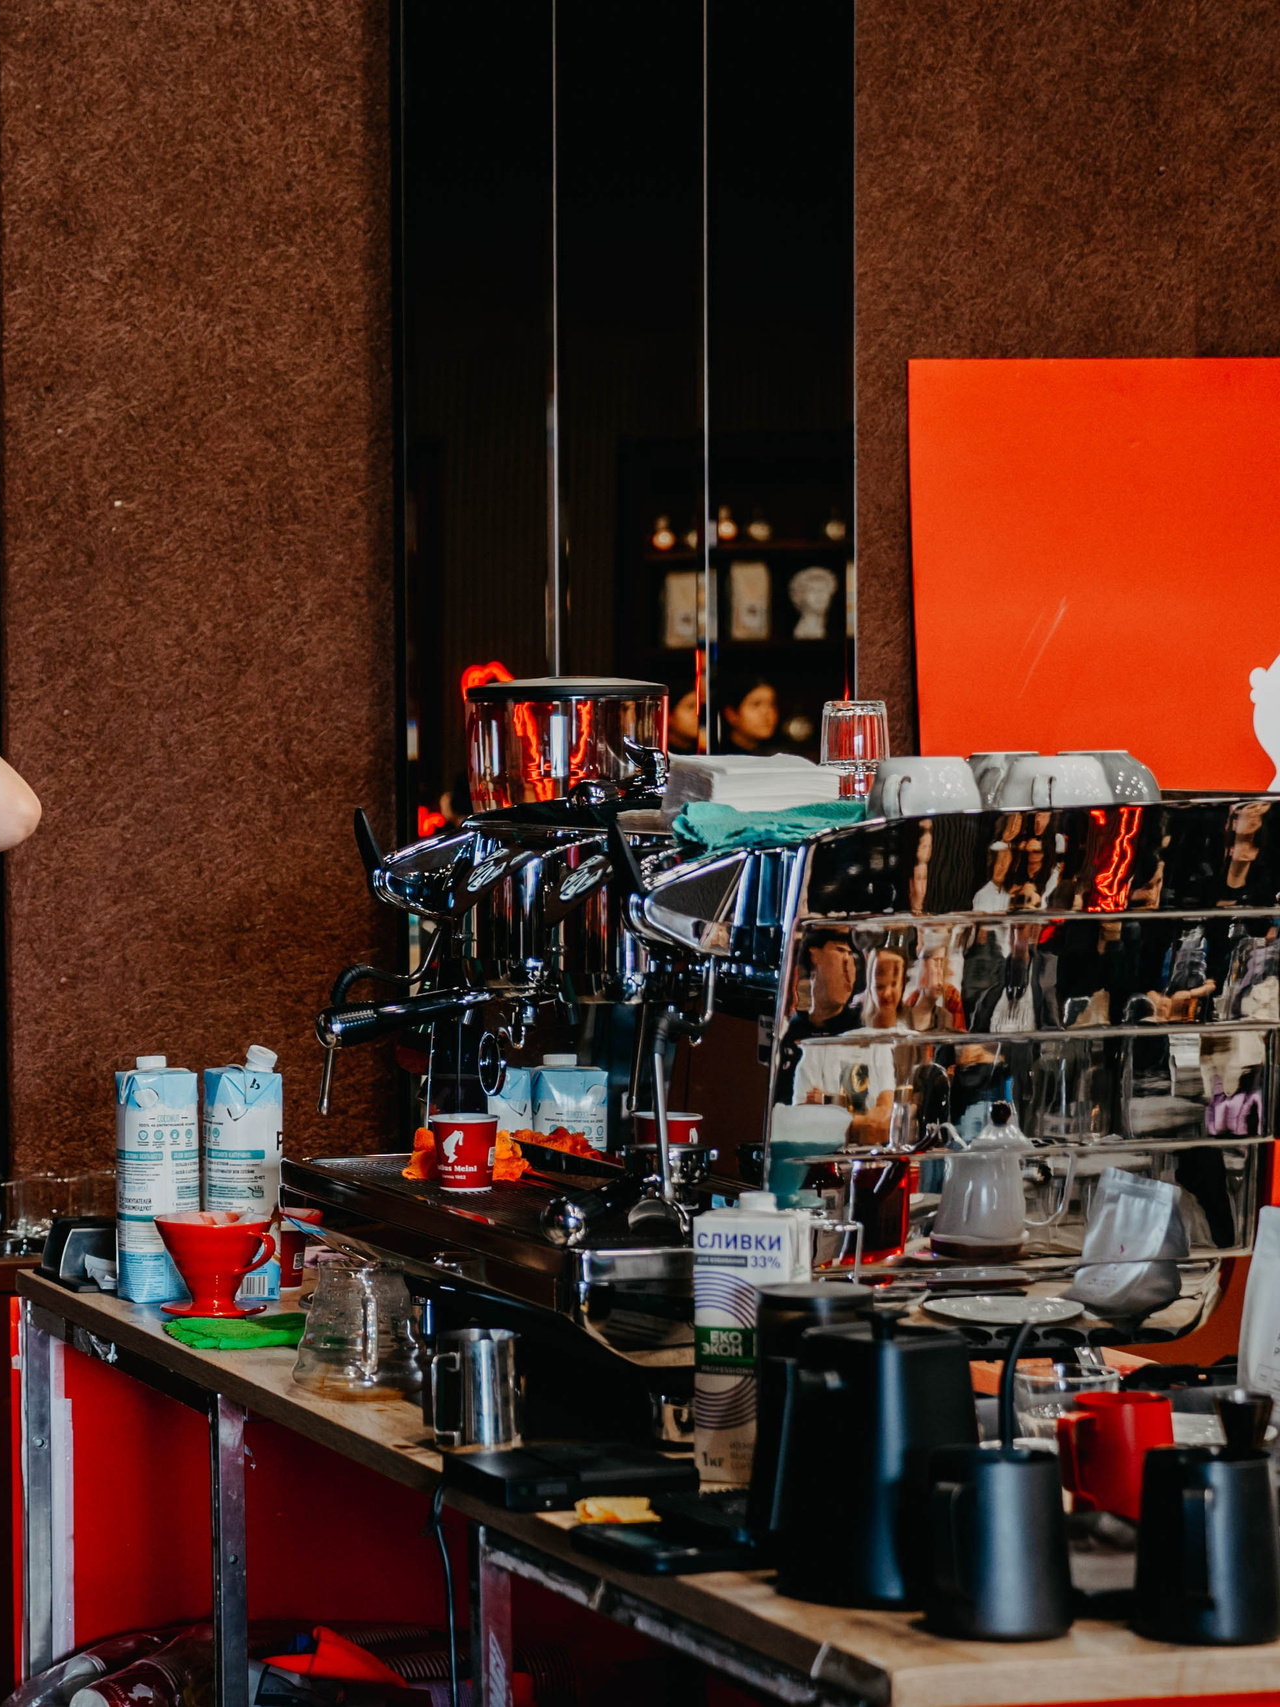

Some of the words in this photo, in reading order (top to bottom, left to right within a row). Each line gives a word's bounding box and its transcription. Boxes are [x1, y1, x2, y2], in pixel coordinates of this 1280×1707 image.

[697, 1233, 781, 1251] СЛИВКИ
[750, 1256, 781, 1268] 33%
[701, 1365, 755, 1374] PROFESSIONA
